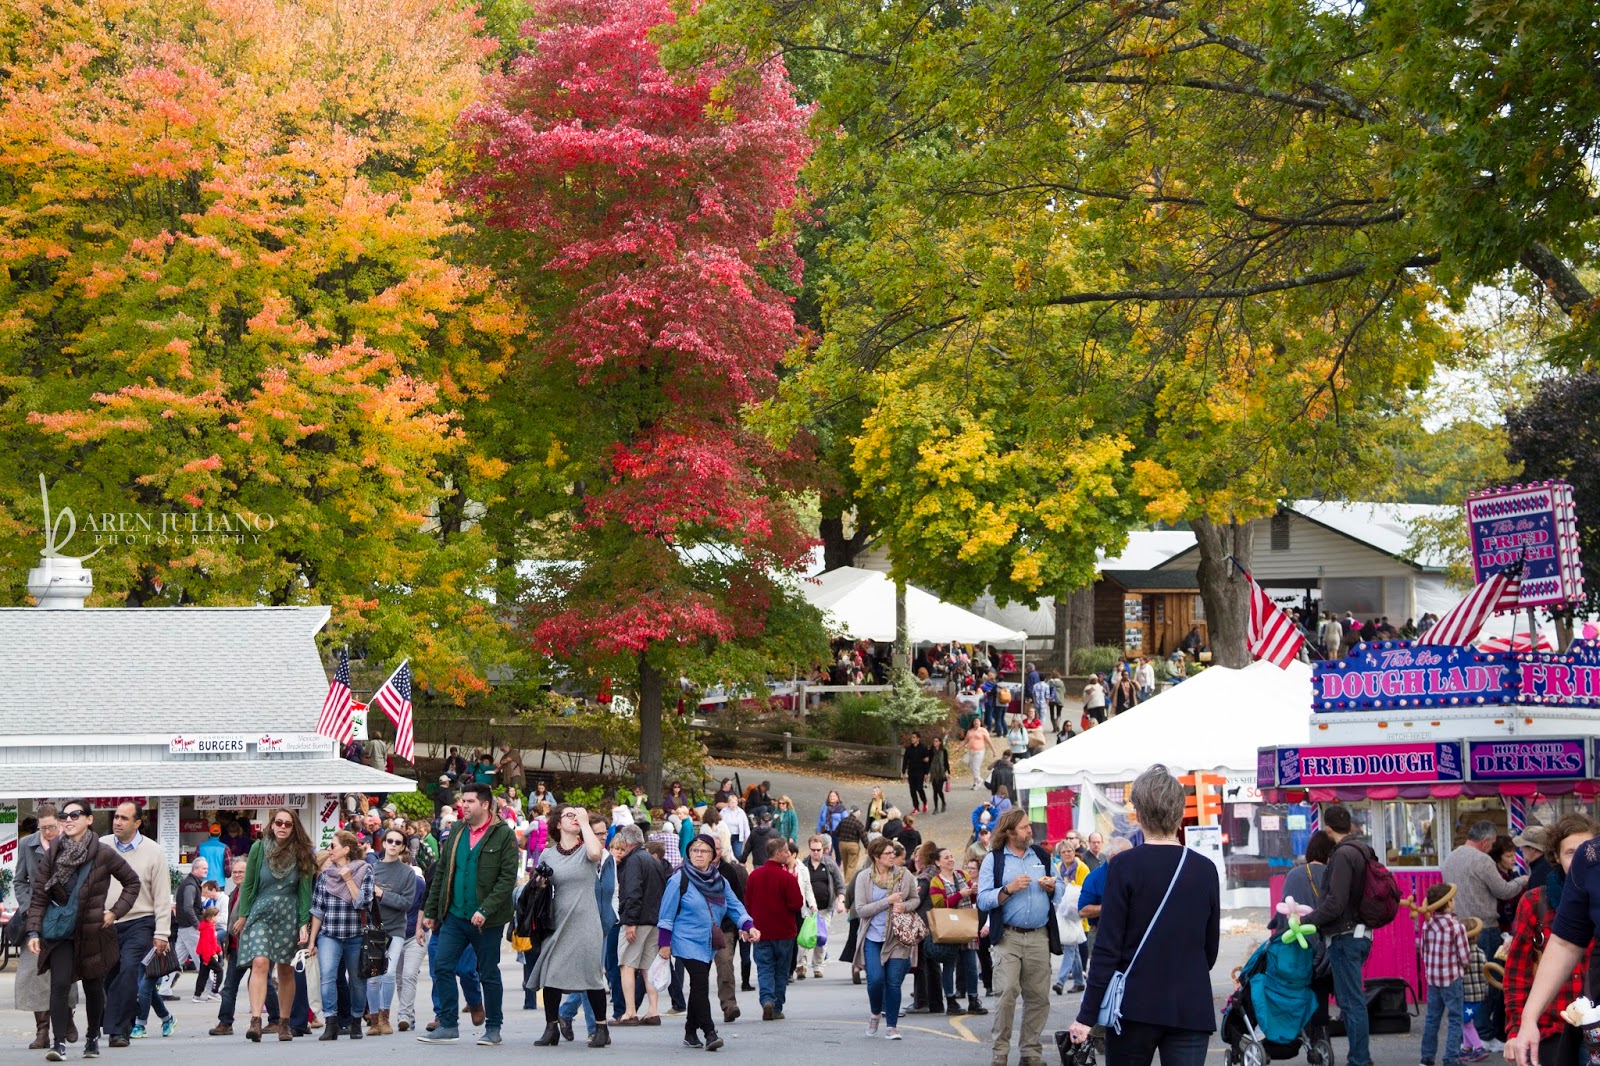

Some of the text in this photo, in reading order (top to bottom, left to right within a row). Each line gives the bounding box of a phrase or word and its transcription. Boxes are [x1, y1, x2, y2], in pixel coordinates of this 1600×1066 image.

[1479, 544, 1556, 568] DOUGH
[1381, 649, 1443, 669] Tish the
[1322, 665, 1506, 699] DOUGH LADY
[198, 740, 244, 751] BURGERS
[286, 742, 311, 751] Breakfast
[1492, 743, 1564, 755] HOT & COLD
[1302, 755, 1366, 778] FRIED
[1368, 752, 1436, 775] DOUGH
[1475, 752, 1582, 773] DRINKS
[1240, 776, 1258, 784] SHEE
[218, 793, 306, 808] Greek Chicken Salad Wrap
